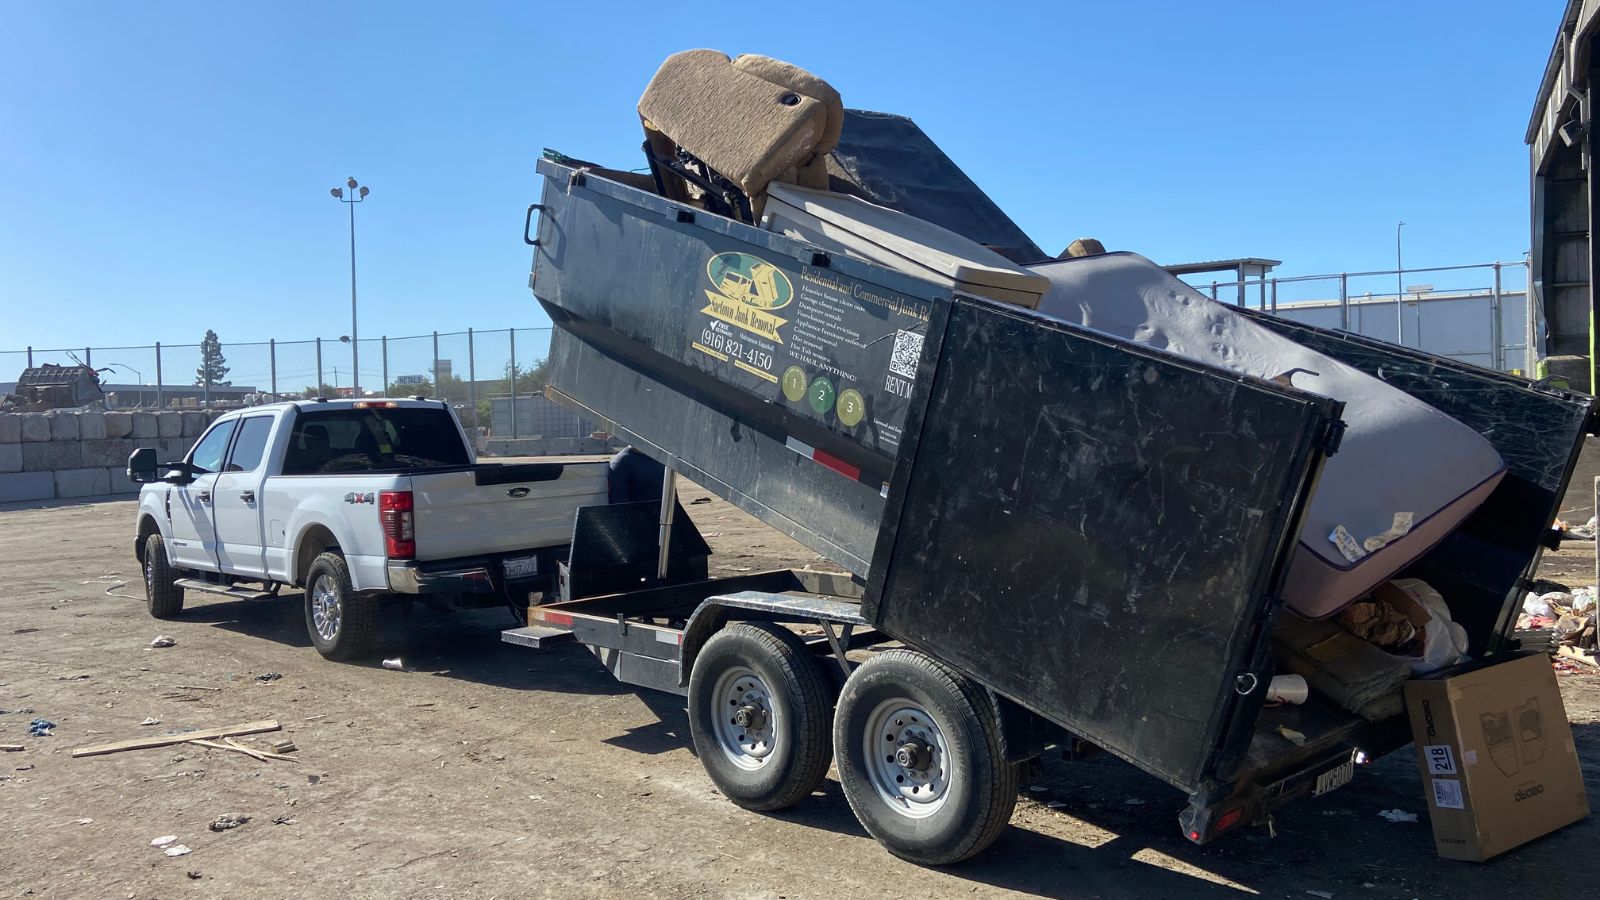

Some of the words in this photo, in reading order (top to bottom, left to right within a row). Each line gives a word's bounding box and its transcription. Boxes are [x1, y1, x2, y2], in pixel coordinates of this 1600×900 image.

[801, 266, 838, 290] Residential
[839, 282, 853, 295] and
[854, 284, 899, 311] Commercial
[897, 298, 917, 318] Junk
[801, 293, 818, 305] Garage
[819, 300, 832, 310] clean
[824, 293, 838, 303] house
[839, 298, 853, 308] clean
[735, 305, 749, 326] Junk
[750, 311, 776, 335] Removal
[796, 318, 821, 332] Appliance
[826, 321, 836, 329] and
[701, 328, 724, 352] (916)
[725, 339, 772, 370] 821-4150
[817, 336, 838, 347] removal
[802, 346, 811, 355] Tub
[789, 350, 799, 359] WE
[800, 354, 818, 367] HAUL
[818, 362, 857, 382] ANYTHING!
[399, 375, 421, 384] METALS
[885, 374, 908, 396] RENT
[818, 389, 825, 400] 2
[846, 401, 854, 413] 3
[1431, 747, 1449, 771] 218
